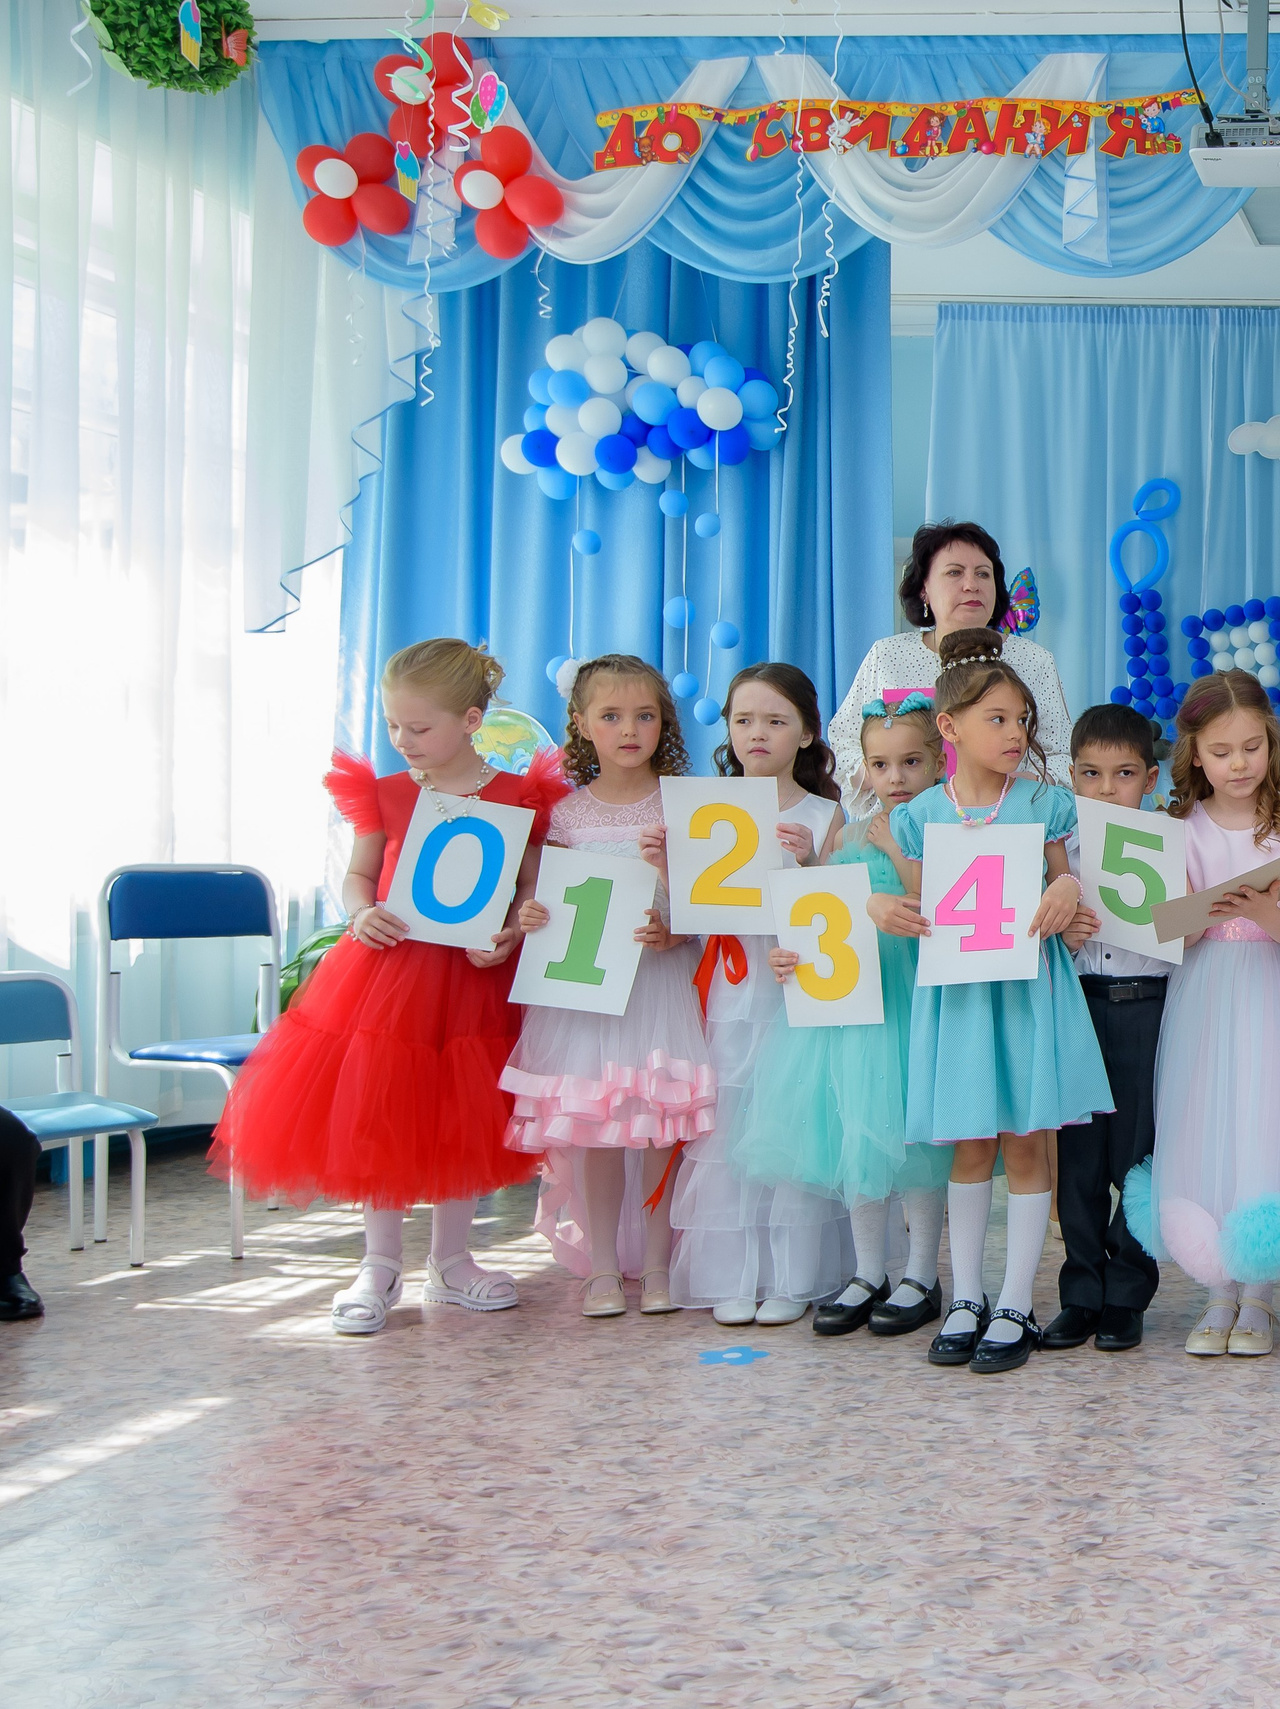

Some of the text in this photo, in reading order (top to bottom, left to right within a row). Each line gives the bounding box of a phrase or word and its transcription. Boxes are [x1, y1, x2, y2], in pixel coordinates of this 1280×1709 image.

[593, 105, 1147, 171] ДО СВИДАНИЯ
[411, 816, 505, 925] 0
[689, 803, 761, 907] 2
[935, 855, 1015, 952] 4
[1099, 824, 1165, 925] 5
[544, 878, 612, 985] 1
[787, 892, 859, 1001] 3
